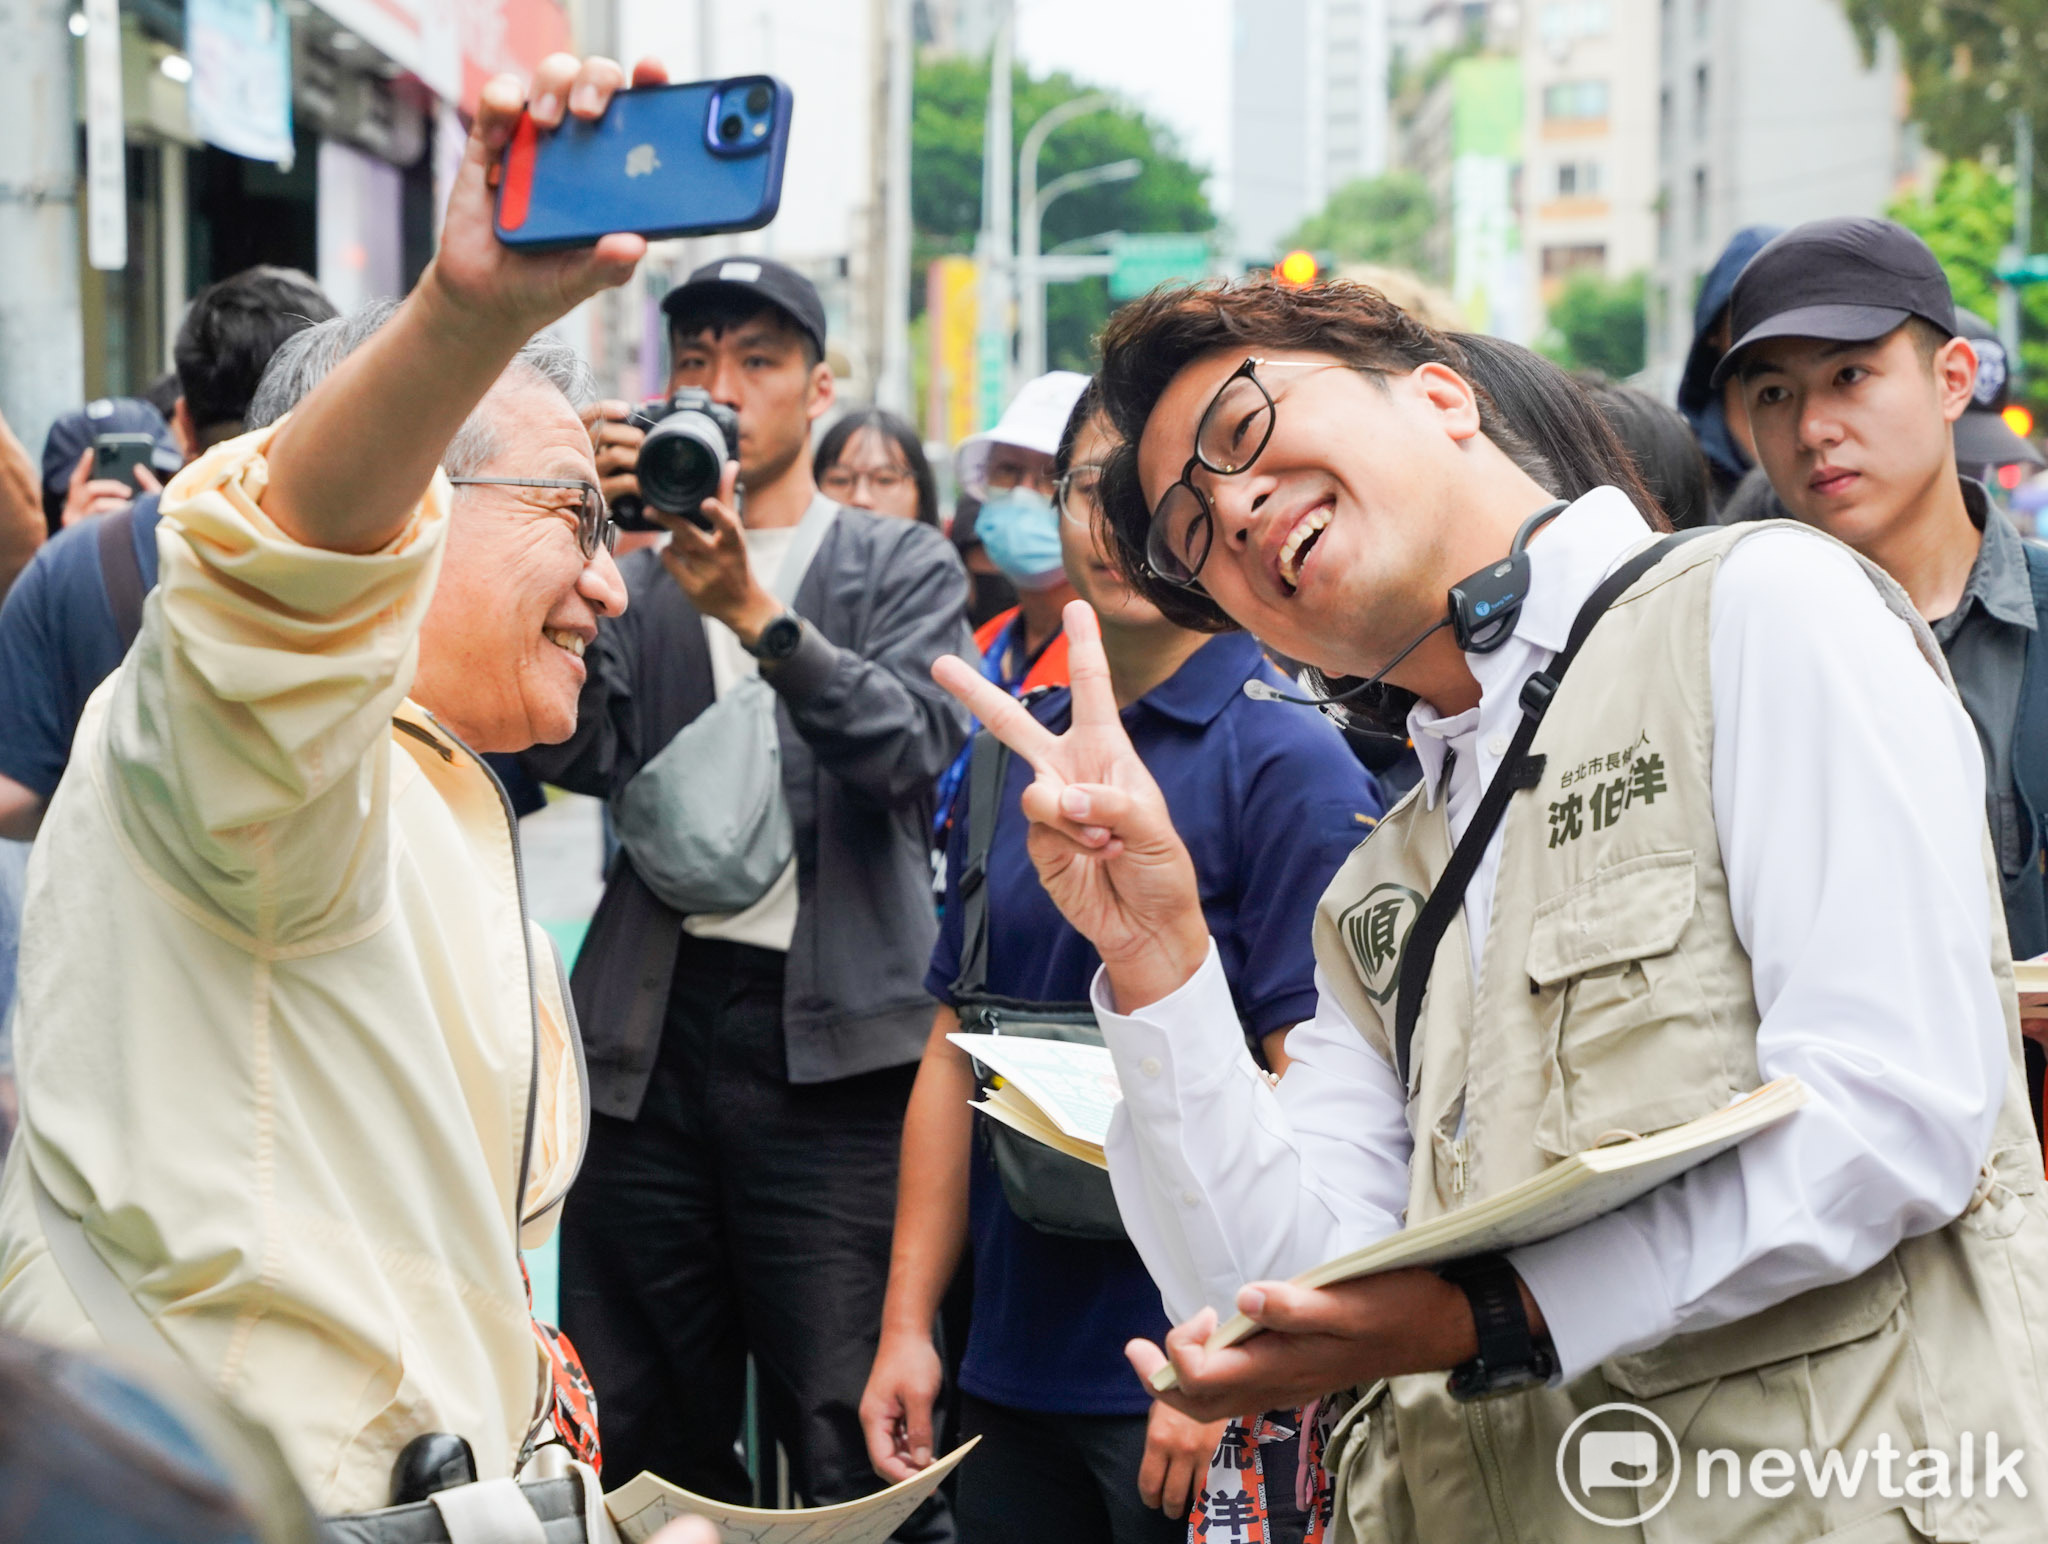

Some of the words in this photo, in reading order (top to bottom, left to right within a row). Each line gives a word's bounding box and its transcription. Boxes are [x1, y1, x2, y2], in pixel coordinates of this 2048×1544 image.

[1548, 752, 1667, 849] 沈伯洋
[1561, 728, 1651, 788] 台北市長人
[1348, 898, 1406, 987] 順
